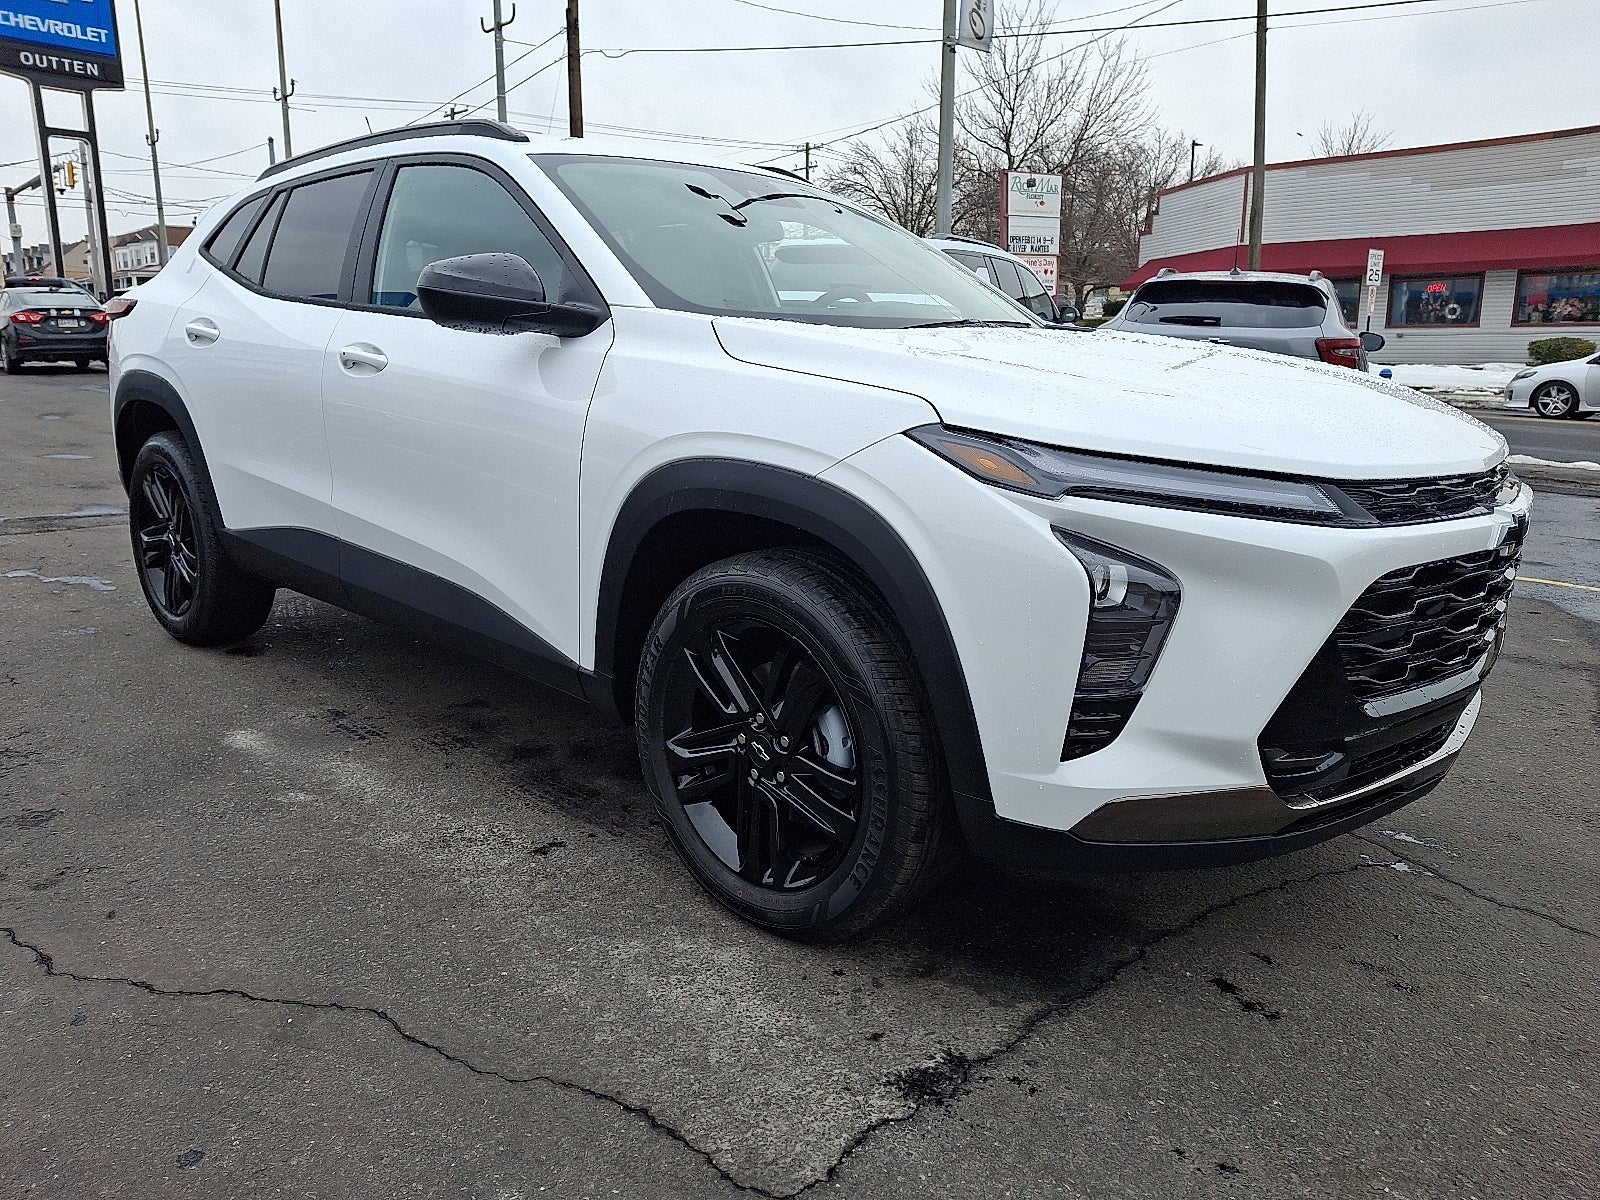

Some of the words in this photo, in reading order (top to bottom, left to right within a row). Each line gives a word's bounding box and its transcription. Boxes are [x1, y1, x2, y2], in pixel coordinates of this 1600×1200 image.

[0, 10, 108, 43] CHEVROLET
[20, 51, 99, 76] OUTTEN
[1010, 236, 1021, 244] OPEN
[1022, 236, 1030, 244] FEB
[1370, 252, 1382, 260] SPEED
[1043, 258, 1054, 268] Day
[1368, 269, 1380, 282] 25
[1427, 284, 1446, 293] OPEN
[850, 748, 887, 891] ASSURANCE
